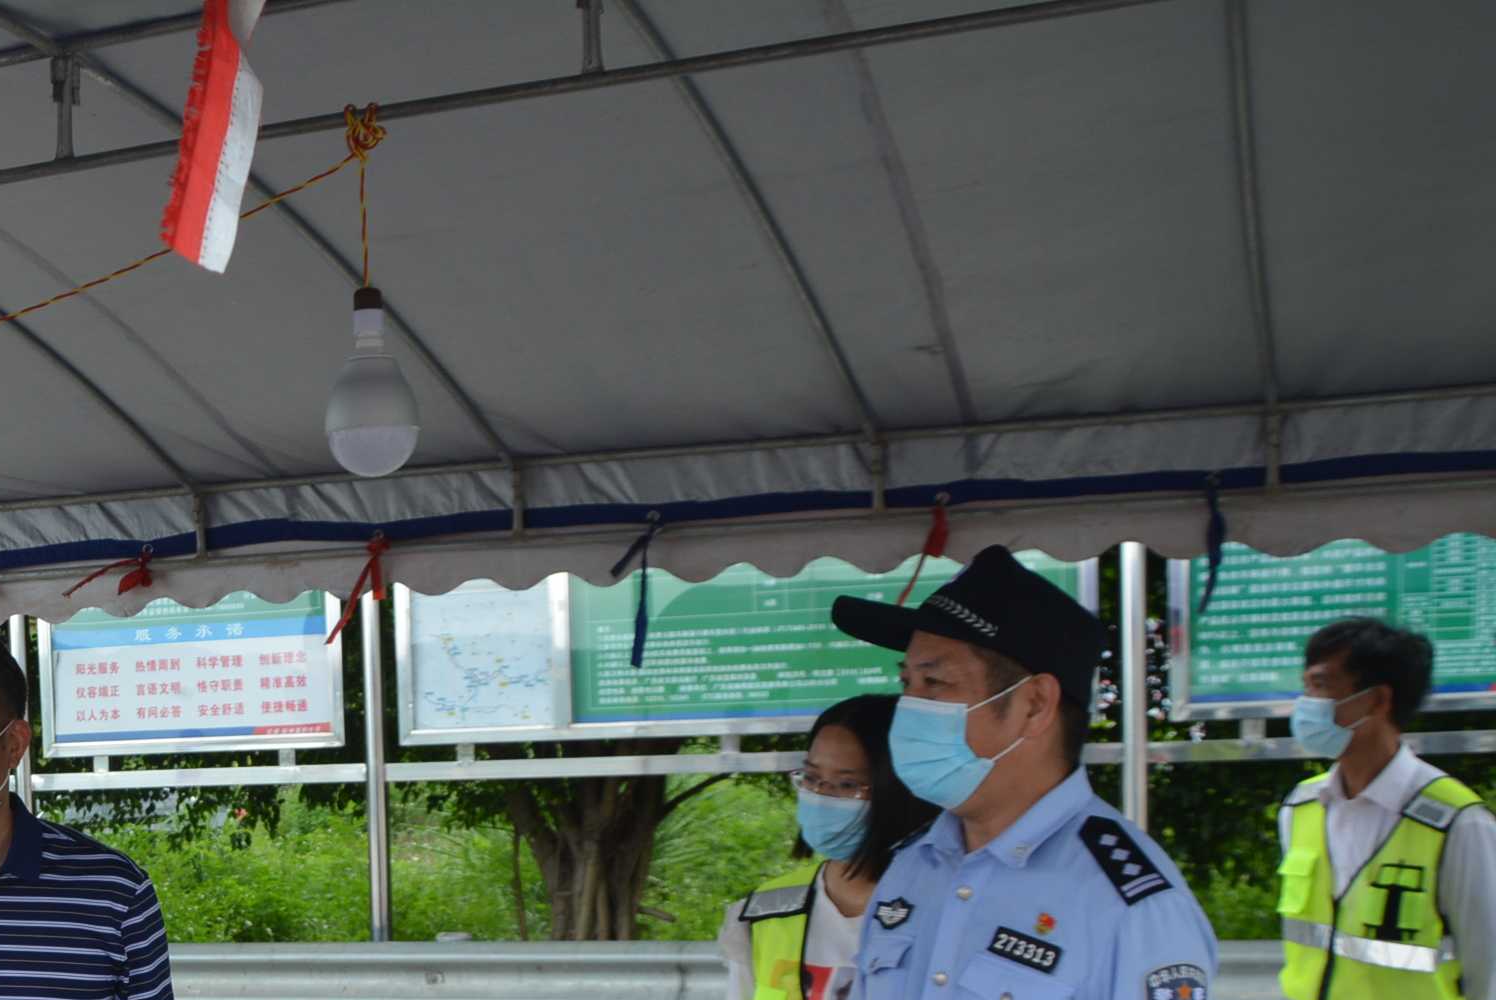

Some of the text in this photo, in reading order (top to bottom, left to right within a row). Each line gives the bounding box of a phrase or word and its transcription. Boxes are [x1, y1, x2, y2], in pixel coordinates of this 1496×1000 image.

[135, 622, 245, 642] 服务承诺
[75, 651, 308, 675] 阳光服务 热情周到 科学管理 创新理念
[75, 674, 307, 698] 仪容端正 言语文明 恪守职责 精准高效
[75, 699, 308, 721] 以人为本 有问必答 安全舒适 便捷畅通
[992, 932, 1056, 967] 273313
